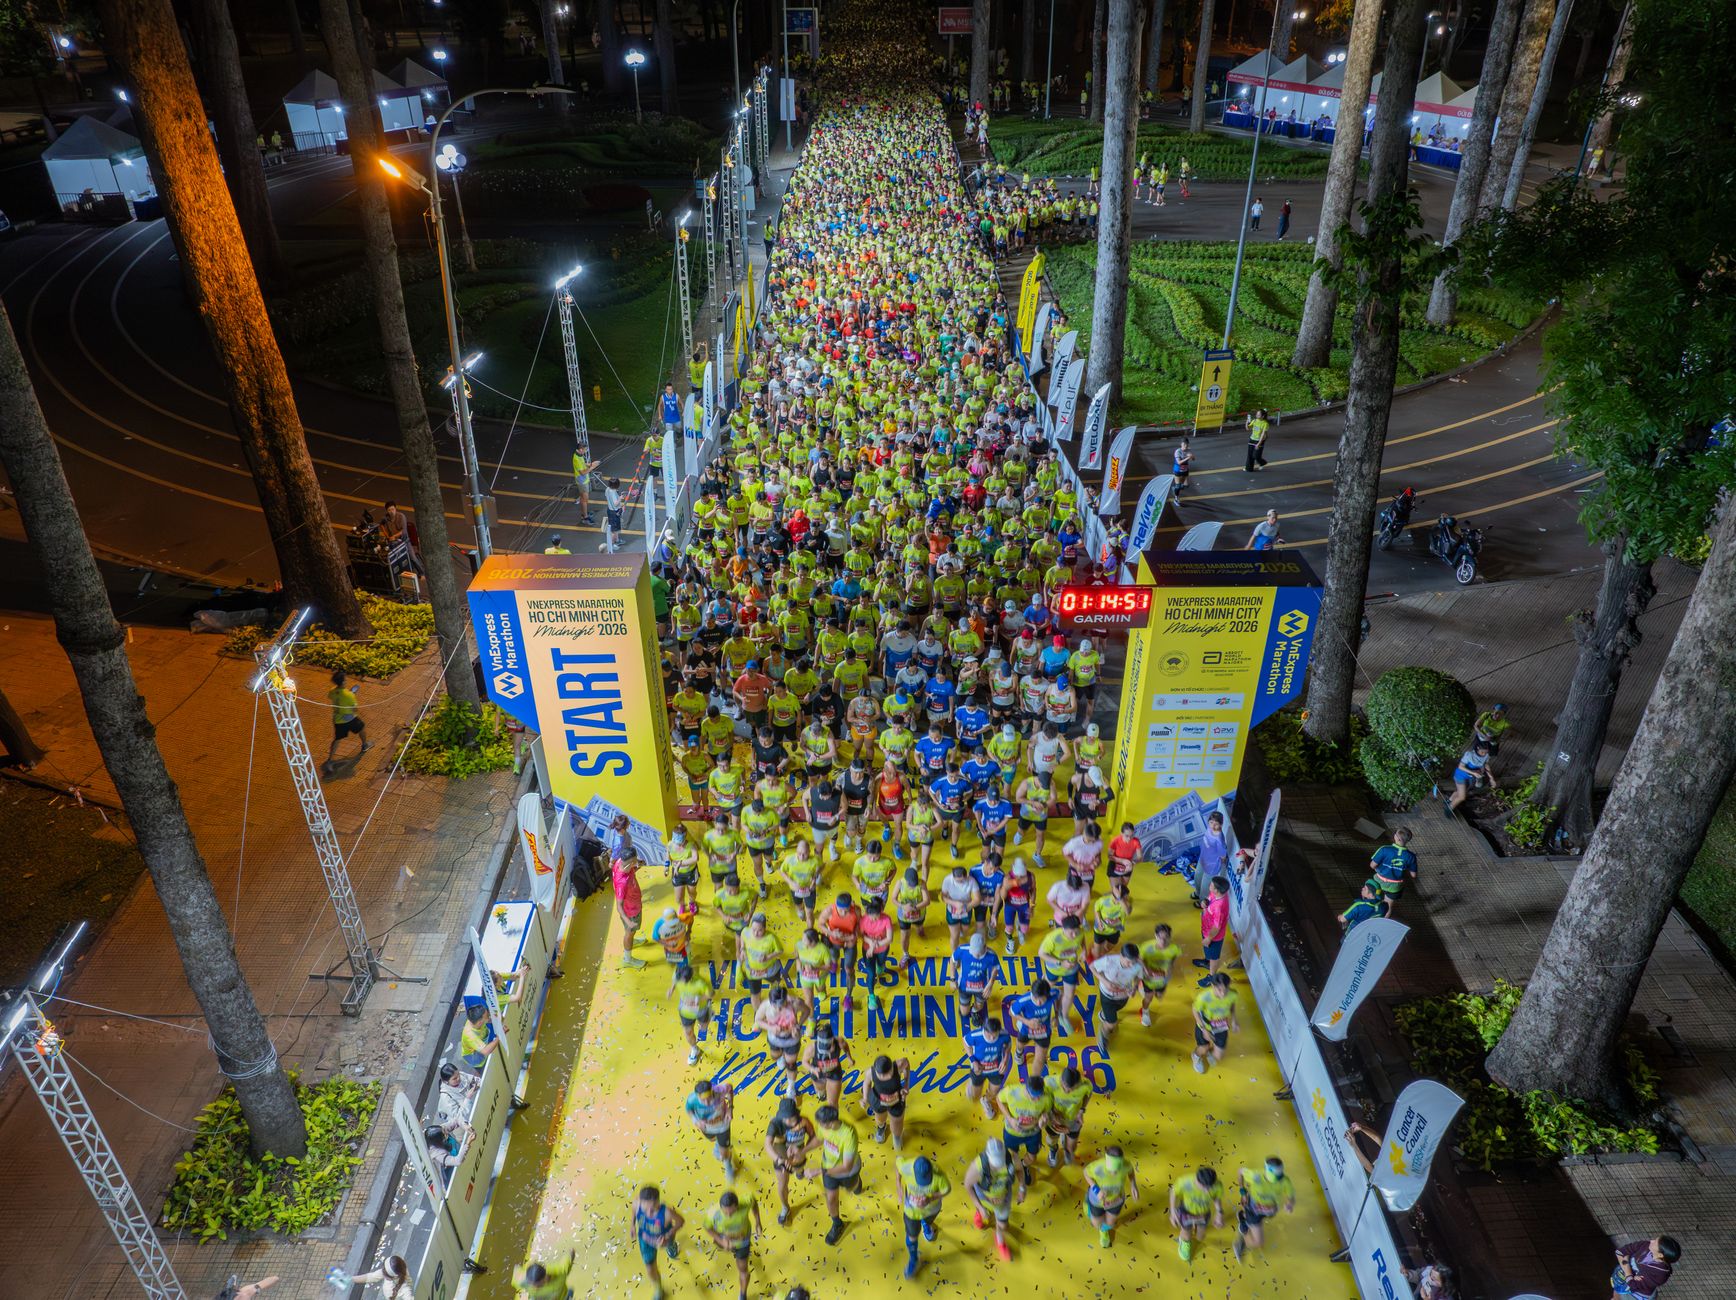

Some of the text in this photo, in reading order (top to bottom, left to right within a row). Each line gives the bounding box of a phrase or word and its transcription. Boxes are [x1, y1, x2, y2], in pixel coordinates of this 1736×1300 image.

[488, 568, 533, 579] 2026
[1255, 562, 1301, 574] 2026
[526, 598, 624, 609] VNEXPRESS MARATHON
[1063, 593, 1149, 611] 01:14:51
[1164, 607, 1262, 620] HO CHI MINH CITY
[1167, 596, 1264, 606] VNEXPRESS MARATHON
[528, 609, 625, 623] HO CHI MINH CITY
[1073, 614, 1131, 624] GARMIN
[1163, 620, 1259, 638] Midnight 2026
[484, 613, 503, 671] VnExpress
[500, 612, 519, 669] Marathon
[533, 623, 628, 641] Midnight 2026
[1266, 640, 1287, 695] Marathon
[1281, 638, 1303, 694] VnExpress
[550, 647, 633, 777] START
[469, 1089, 500, 1184] VELOSAR
[1396, 1105, 1416, 1142] Cancer
[1405, 1115, 1428, 1155] Council
[1323, 1127, 1345, 1180] Council
[1326, 1116, 1346, 1165] Cancer
